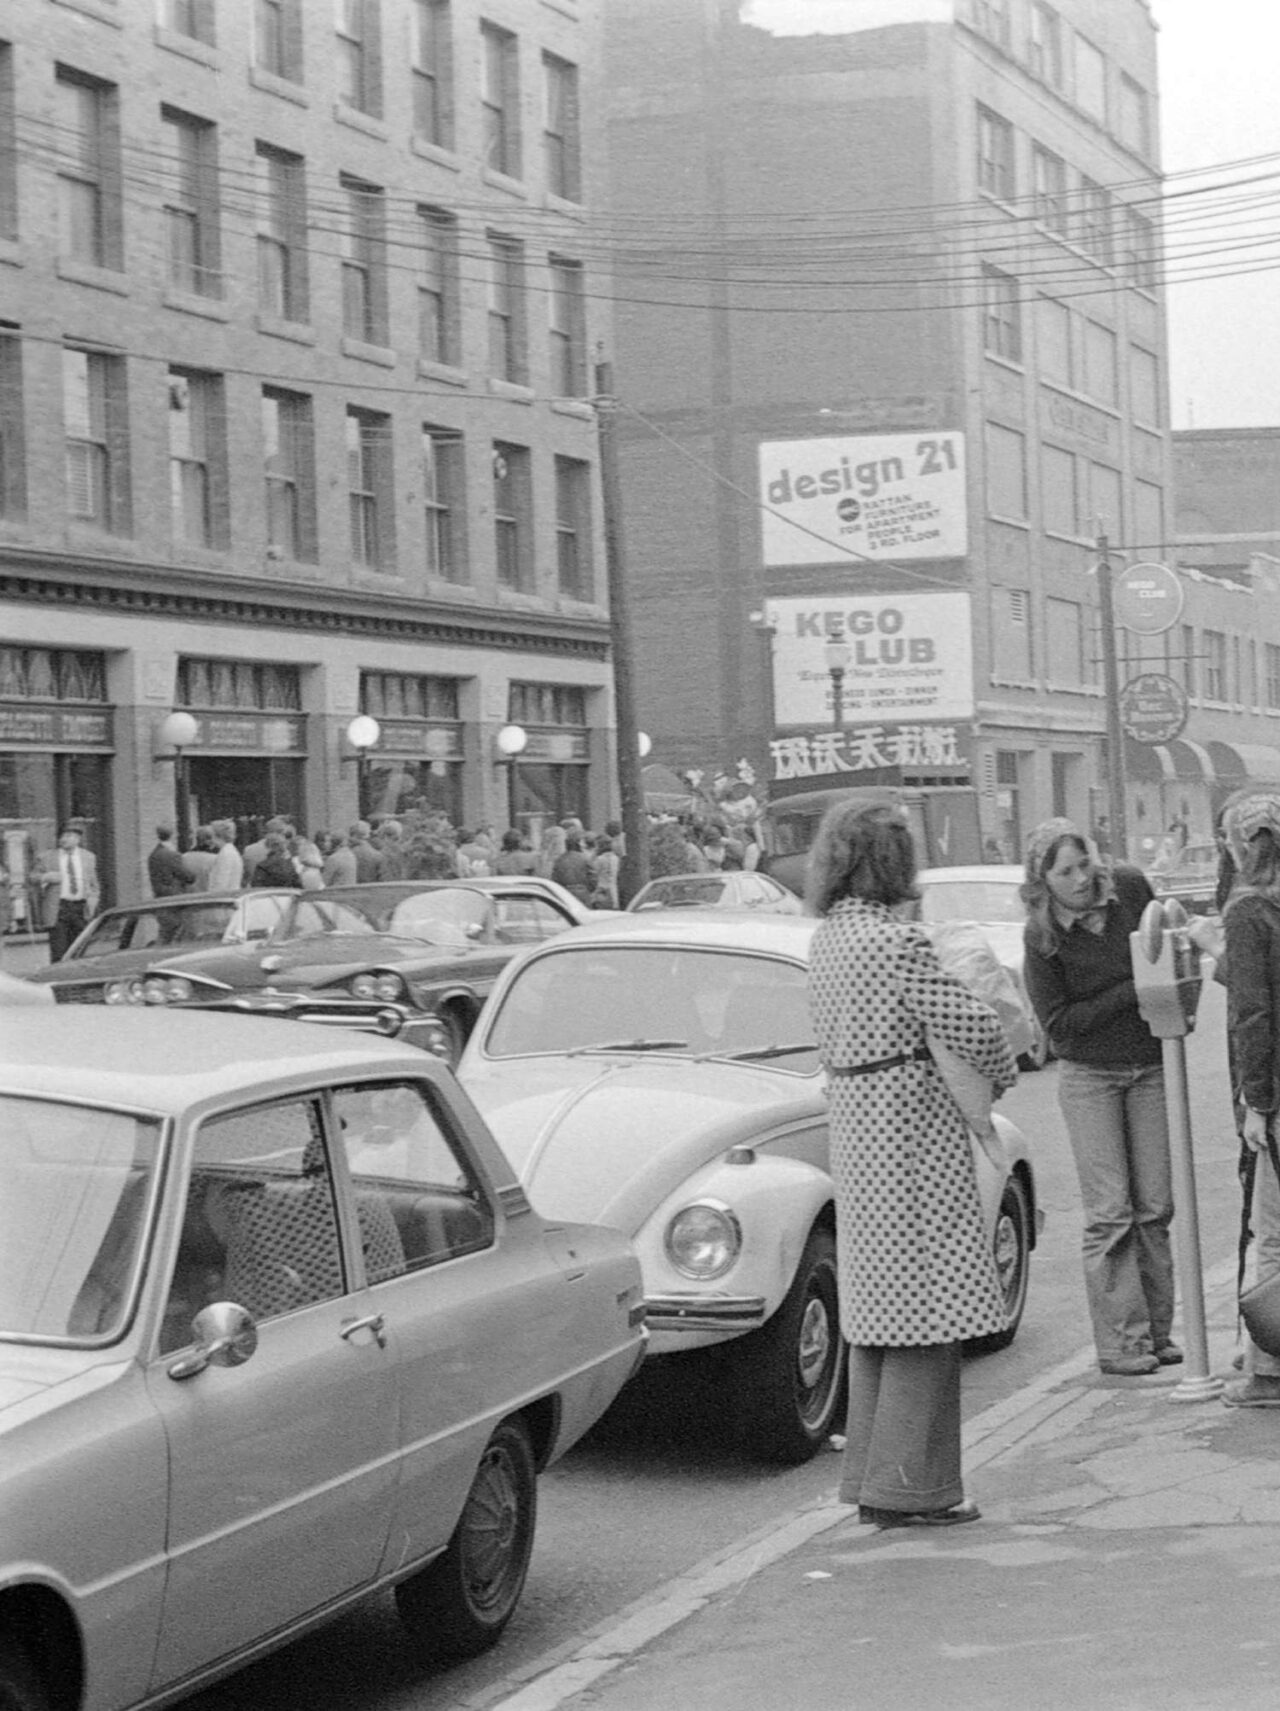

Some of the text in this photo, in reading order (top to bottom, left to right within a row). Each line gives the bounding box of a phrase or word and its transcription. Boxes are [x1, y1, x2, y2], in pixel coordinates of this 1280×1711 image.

[767, 438, 959, 505] design 21
[863, 494, 912, 509] RATTAN
[865, 500, 931, 520] FURNITURE
[840, 508, 940, 535] FOR APARTMENT
[867, 525, 914, 539] PEOPLE
[903, 529, 941, 543] FLOOR
[795, 608, 904, 638] KEGO
[847, 637, 936, 666] LUB
